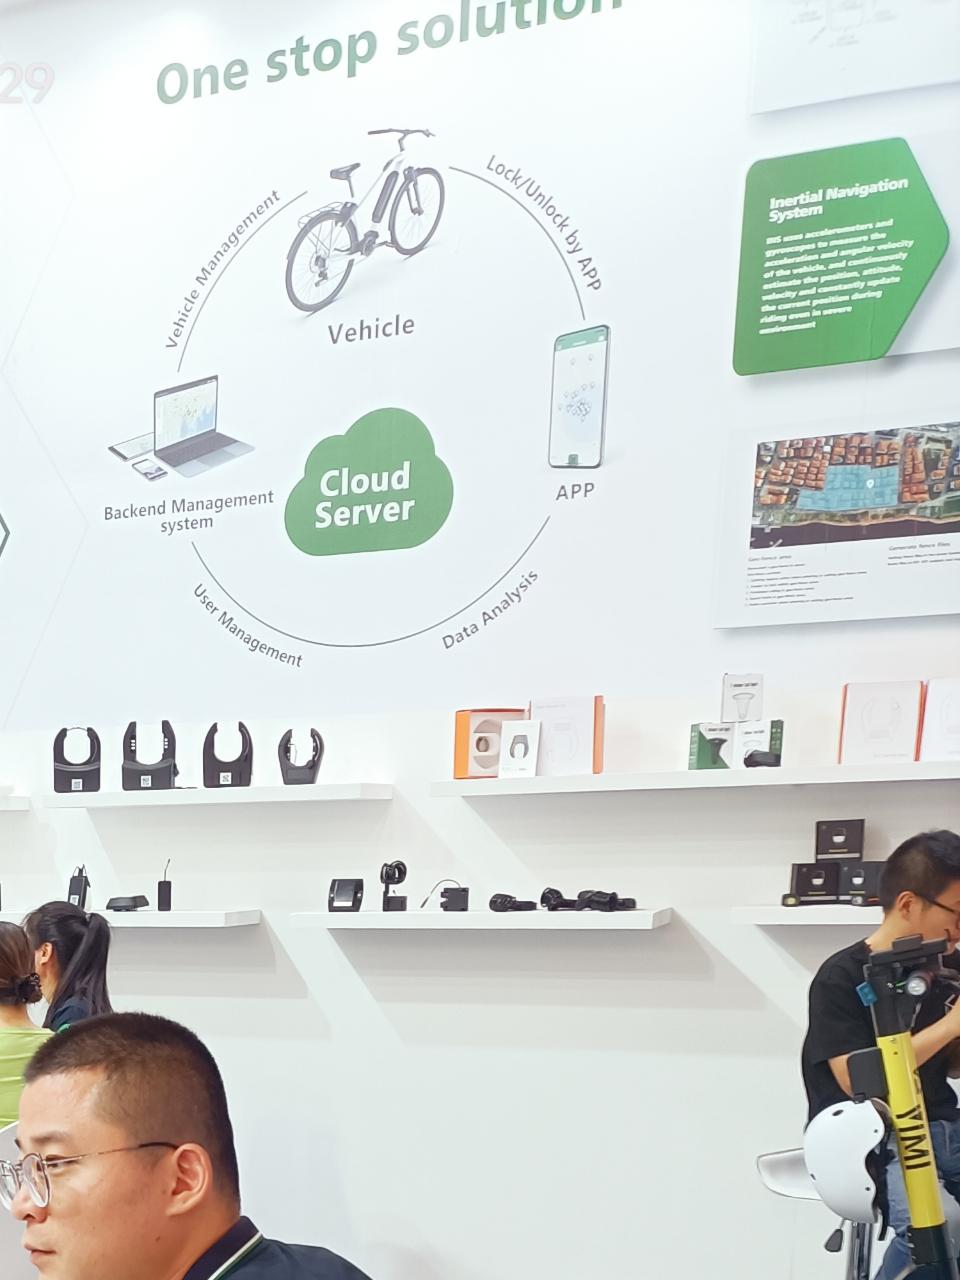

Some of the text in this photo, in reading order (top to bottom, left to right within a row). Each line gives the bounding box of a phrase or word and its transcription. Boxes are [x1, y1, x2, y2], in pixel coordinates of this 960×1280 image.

[156, 58, 249, 105] One
[266, 29, 378, 83] stop
[770, 178, 908, 208] Inertial Navigation
[485, 153, 602, 293] Lock/Unlock by APP
[769, 205, 823, 224] System
[164, 188, 281, 350] Vehicle Management
[328, 314, 415, 346] Vehicle
[320, 461, 411, 498] Cloud
[556, 482, 595, 501] APP
[104, 489, 275, 521] Backend Management
[315, 498, 416, 529] Server
[160, 515, 214, 536] system
[193, 582, 304, 669] User Management
[441, 568, 540, 651] Data Analysis
